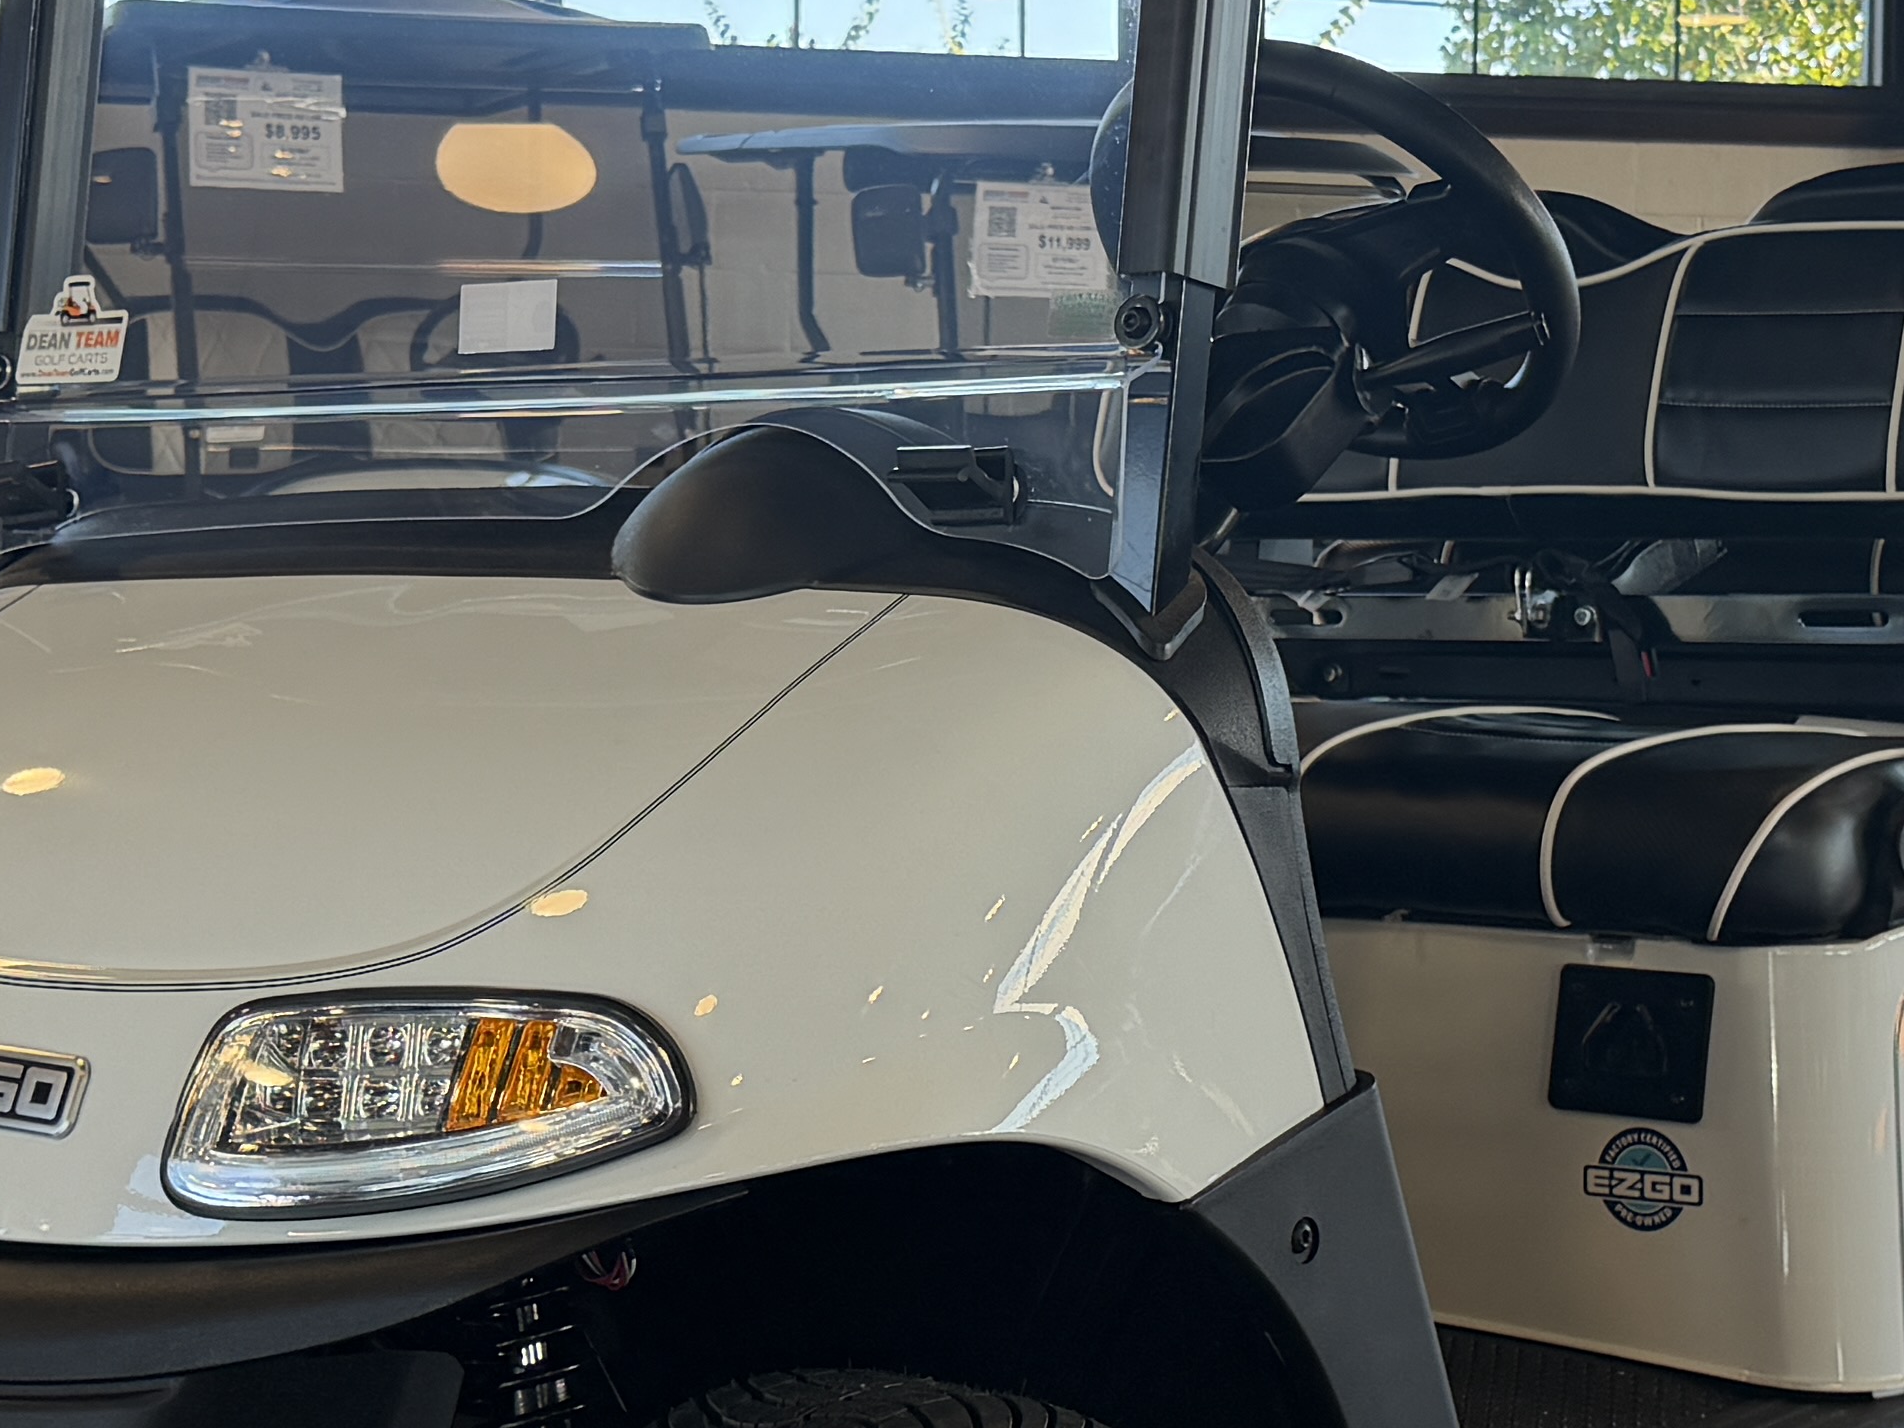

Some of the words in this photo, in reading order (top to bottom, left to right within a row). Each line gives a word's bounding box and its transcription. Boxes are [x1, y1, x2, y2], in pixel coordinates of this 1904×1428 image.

[265, 123, 322, 141] $8,995
[1038, 234, 1091, 251] $11,999
[26, 332, 72, 351] DEAN
[75, 329, 121, 349] TEAM
[34, 353, 66, 366] GOLF
[69, 350, 109, 366] CARTS
[1604, 1131, 1640, 1163] FACTORY
[1639, 1131, 1682, 1170] CERTIFIED
[1585, 1167, 1701, 1204] EZGO
